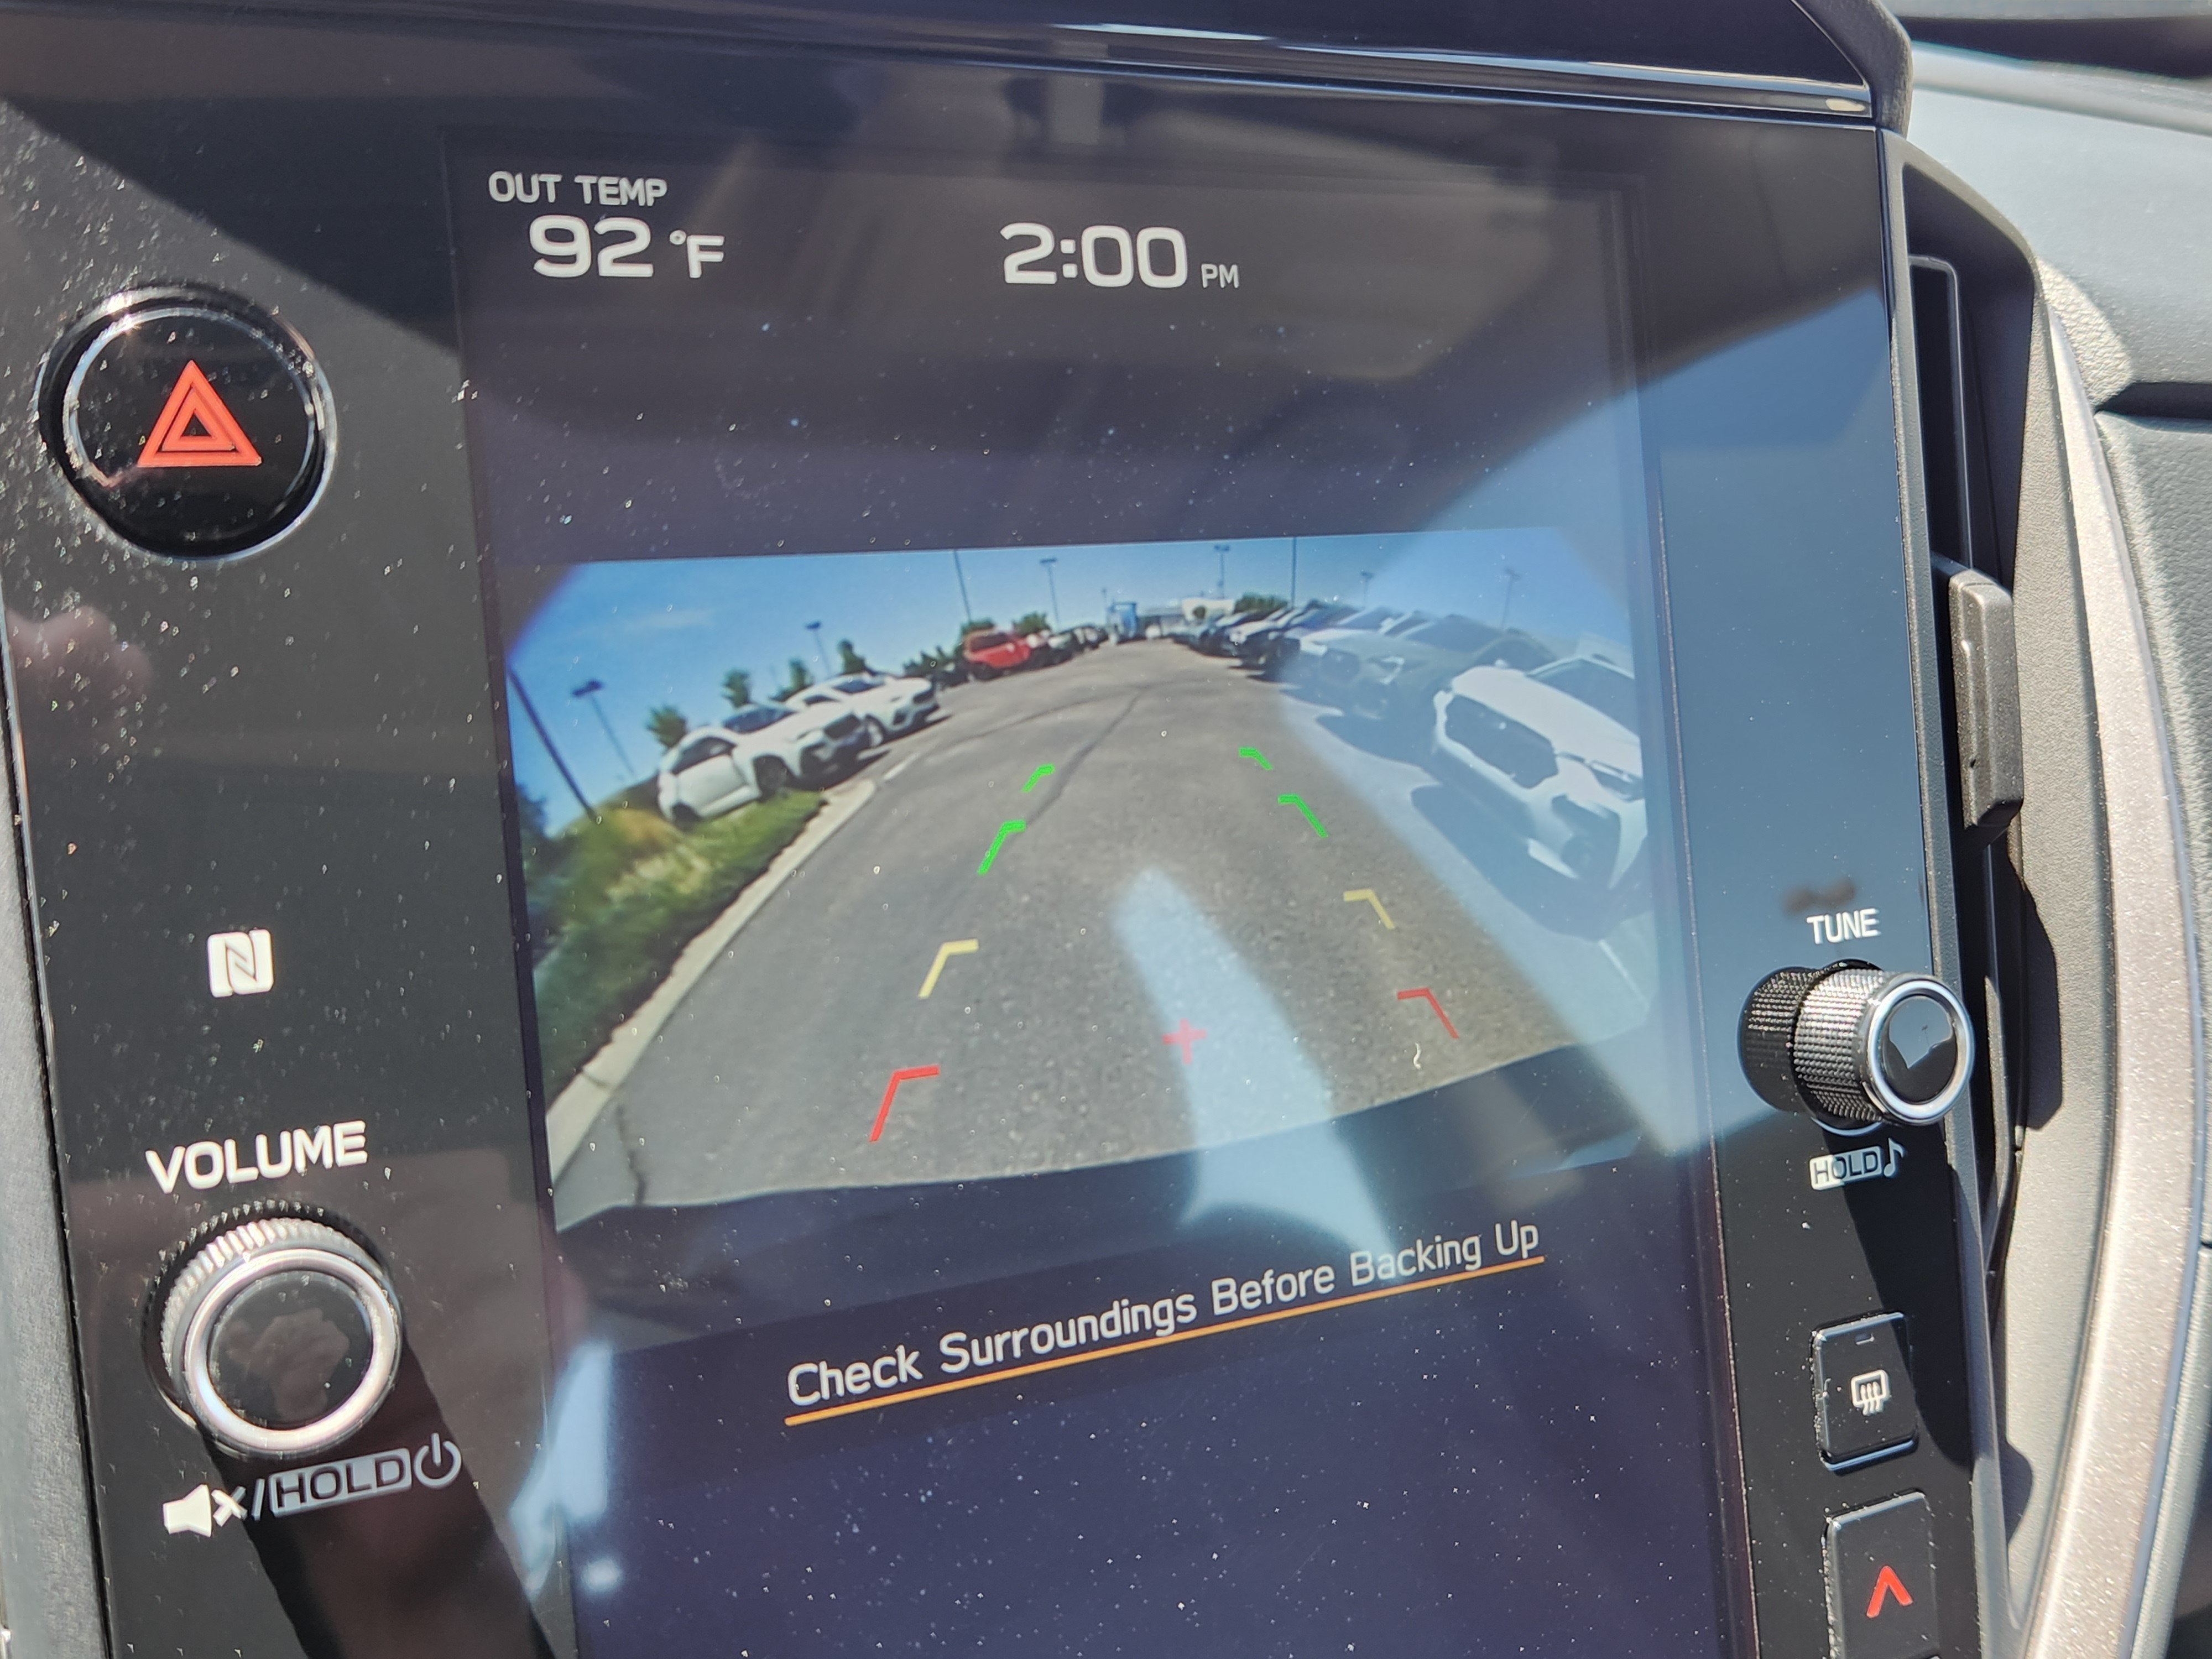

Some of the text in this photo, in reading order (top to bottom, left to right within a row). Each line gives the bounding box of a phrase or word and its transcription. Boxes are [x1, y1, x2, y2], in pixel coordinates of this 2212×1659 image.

[488, 171, 667, 206] OUT TEMP
[529, 215, 654, 278] 92
[1000, 222, 1239, 288] 2:00 PM
[1807, 908, 1881, 944] TUNE
[145, 1120, 368, 1193] VOLUME
[1813, 1149, 1880, 1186] HOLD
[787, 1219, 1539, 1406] Check Surroundings Before Backing Up
